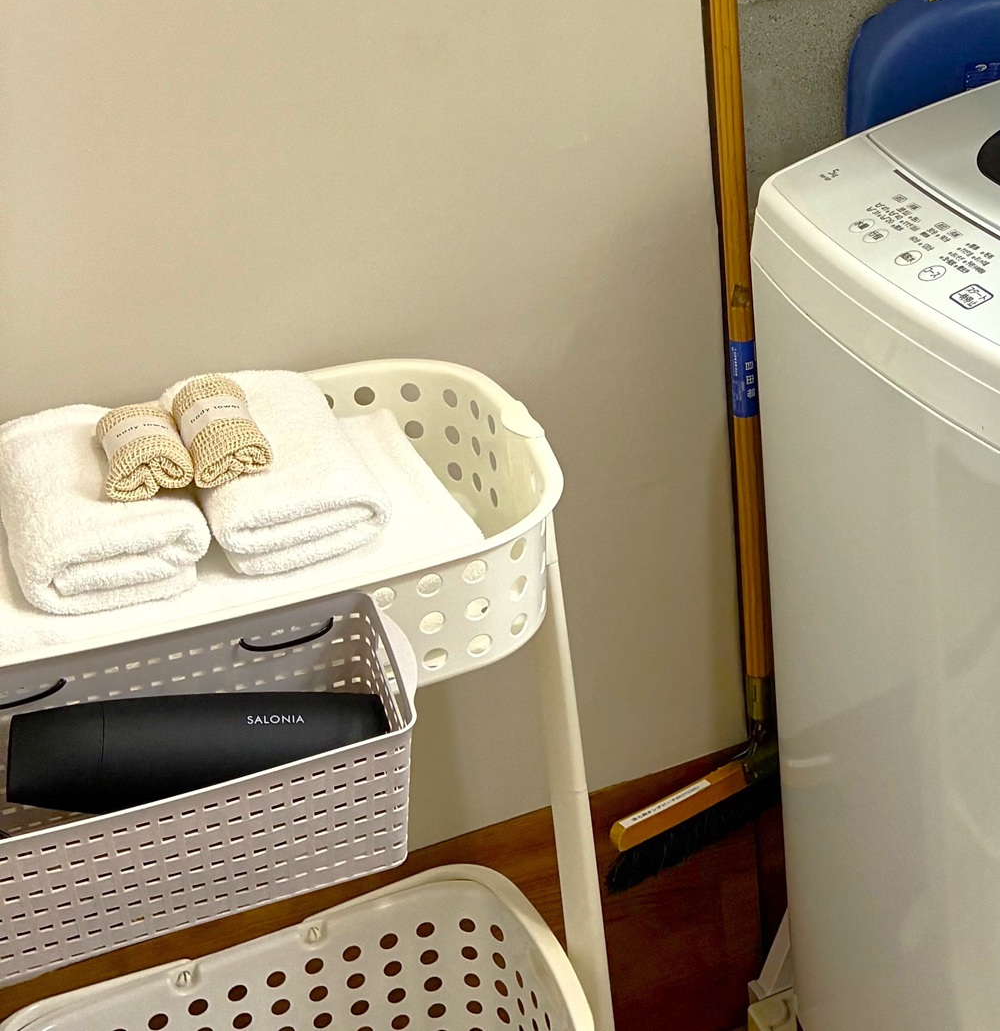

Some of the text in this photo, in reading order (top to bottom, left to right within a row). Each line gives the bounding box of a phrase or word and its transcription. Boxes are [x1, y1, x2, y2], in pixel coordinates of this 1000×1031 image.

[966, 287, 988, 301] スタート
[190, 407, 210, 424] body
[246, 714, 305, 725] SALONIA
